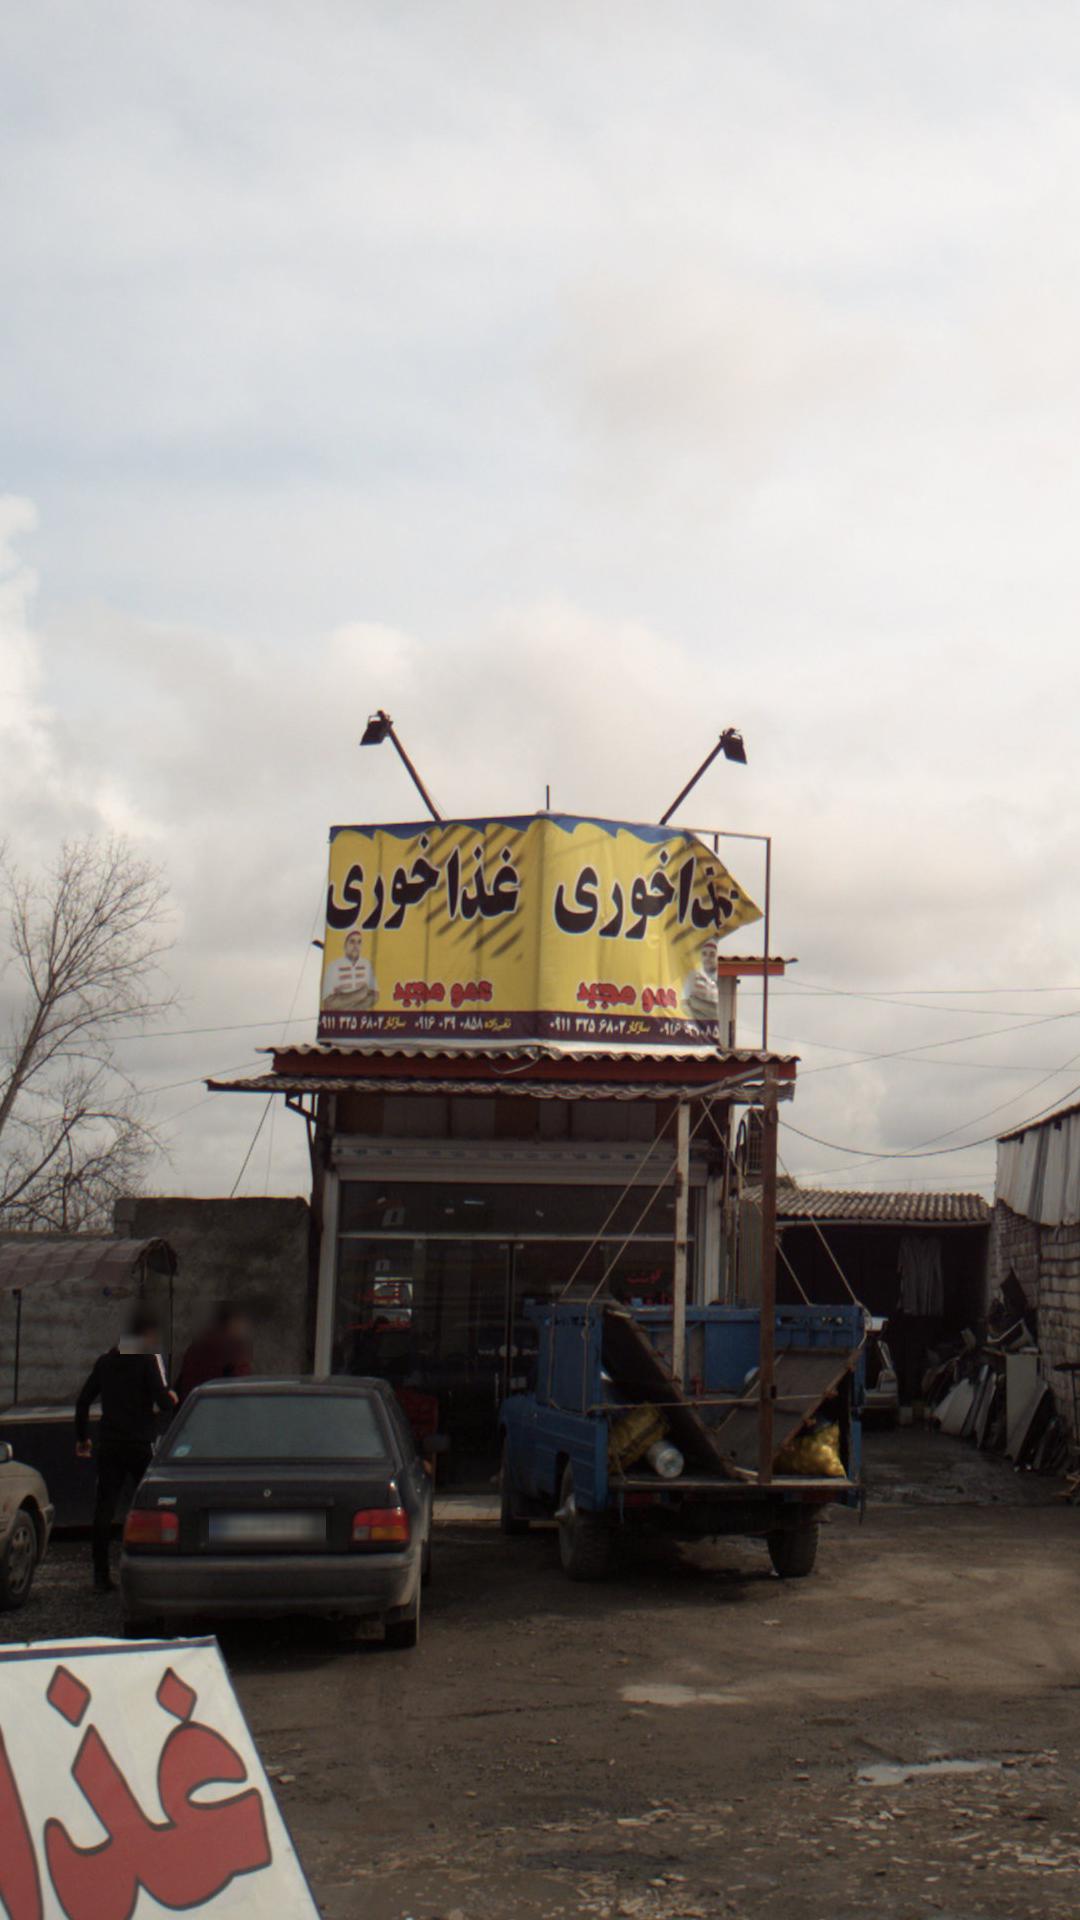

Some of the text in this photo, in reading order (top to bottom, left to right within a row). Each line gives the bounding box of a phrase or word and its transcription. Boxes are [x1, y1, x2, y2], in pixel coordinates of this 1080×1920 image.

[326, 835, 521, 930] غذاخوری
[393, 980, 493, 1008] عمو مجید
[576, 981, 637, 1009] مجید
